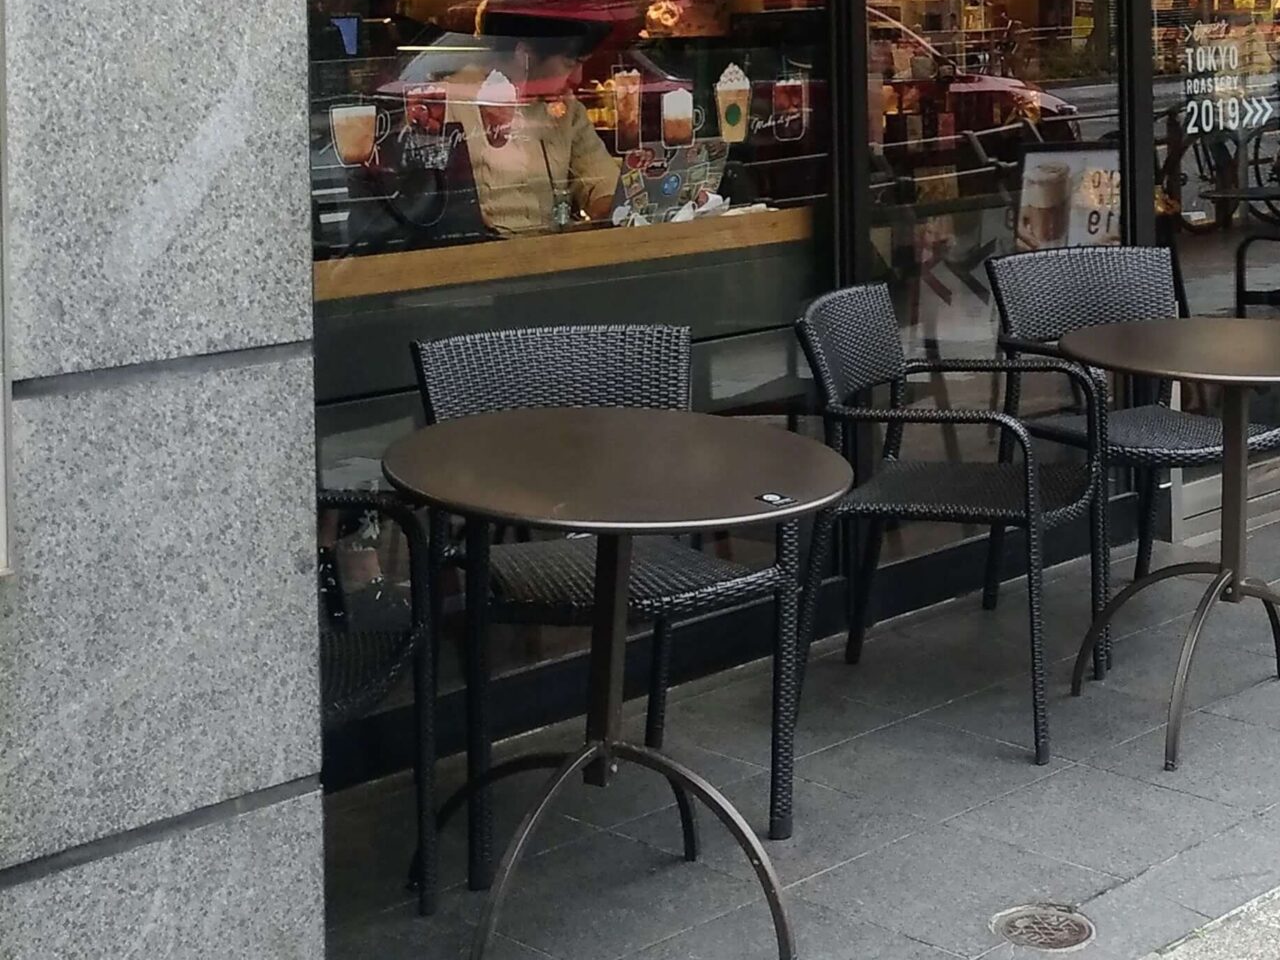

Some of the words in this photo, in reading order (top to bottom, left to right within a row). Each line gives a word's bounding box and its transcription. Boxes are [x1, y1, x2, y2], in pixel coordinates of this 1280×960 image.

[1185, 45, 1238, 73] TOKYO
[1186, 75, 1239, 95] ROASTERY
[1186, 97, 1240, 135] 2019
